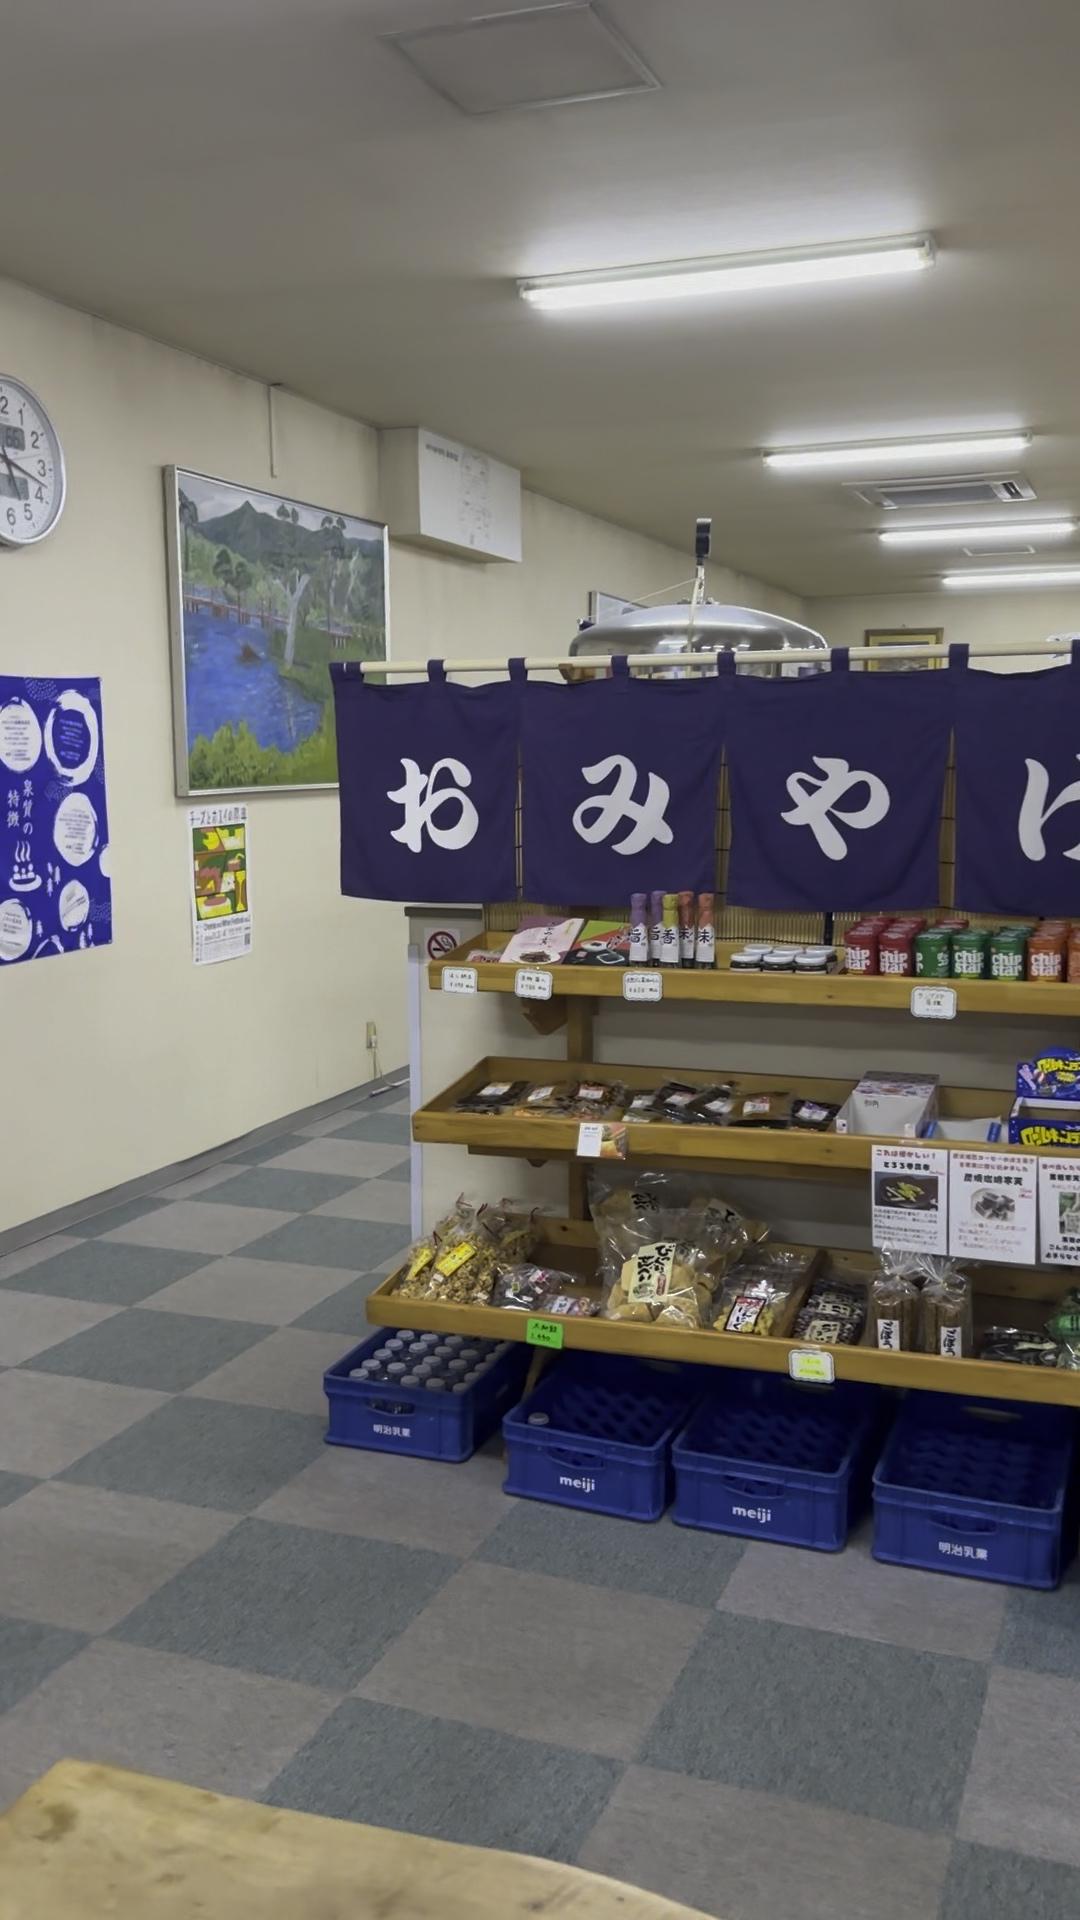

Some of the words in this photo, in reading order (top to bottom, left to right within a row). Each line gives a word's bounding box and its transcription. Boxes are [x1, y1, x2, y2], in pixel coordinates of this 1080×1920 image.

[18, 407, 24, 426] 1
[30, 431, 40, 449] 2
[37, 459, 47, 478] 3
[34, 486, 44, 502] 4
[6, 507, 17, 526] 6
[24, 503, 33, 521] 5
[7, 789, 20, 829] 特徴
[880, 950, 908, 963] chip
[954, 950, 984, 963] chip
[992, 952, 1022, 965] chip
[1031, 952, 1061, 965] chip
[880, 962, 908, 974] star
[954, 962, 984, 973] star
[992, 964, 1022, 976] star
[1031, 964, 1061, 976] star
[373, 1423, 411, 1438] 明治乳業
[559, 1476, 596, 1492] meiji
[732, 1505, 771, 1523] meiji
[938, 1541, 988, 1561] 明治乳業
